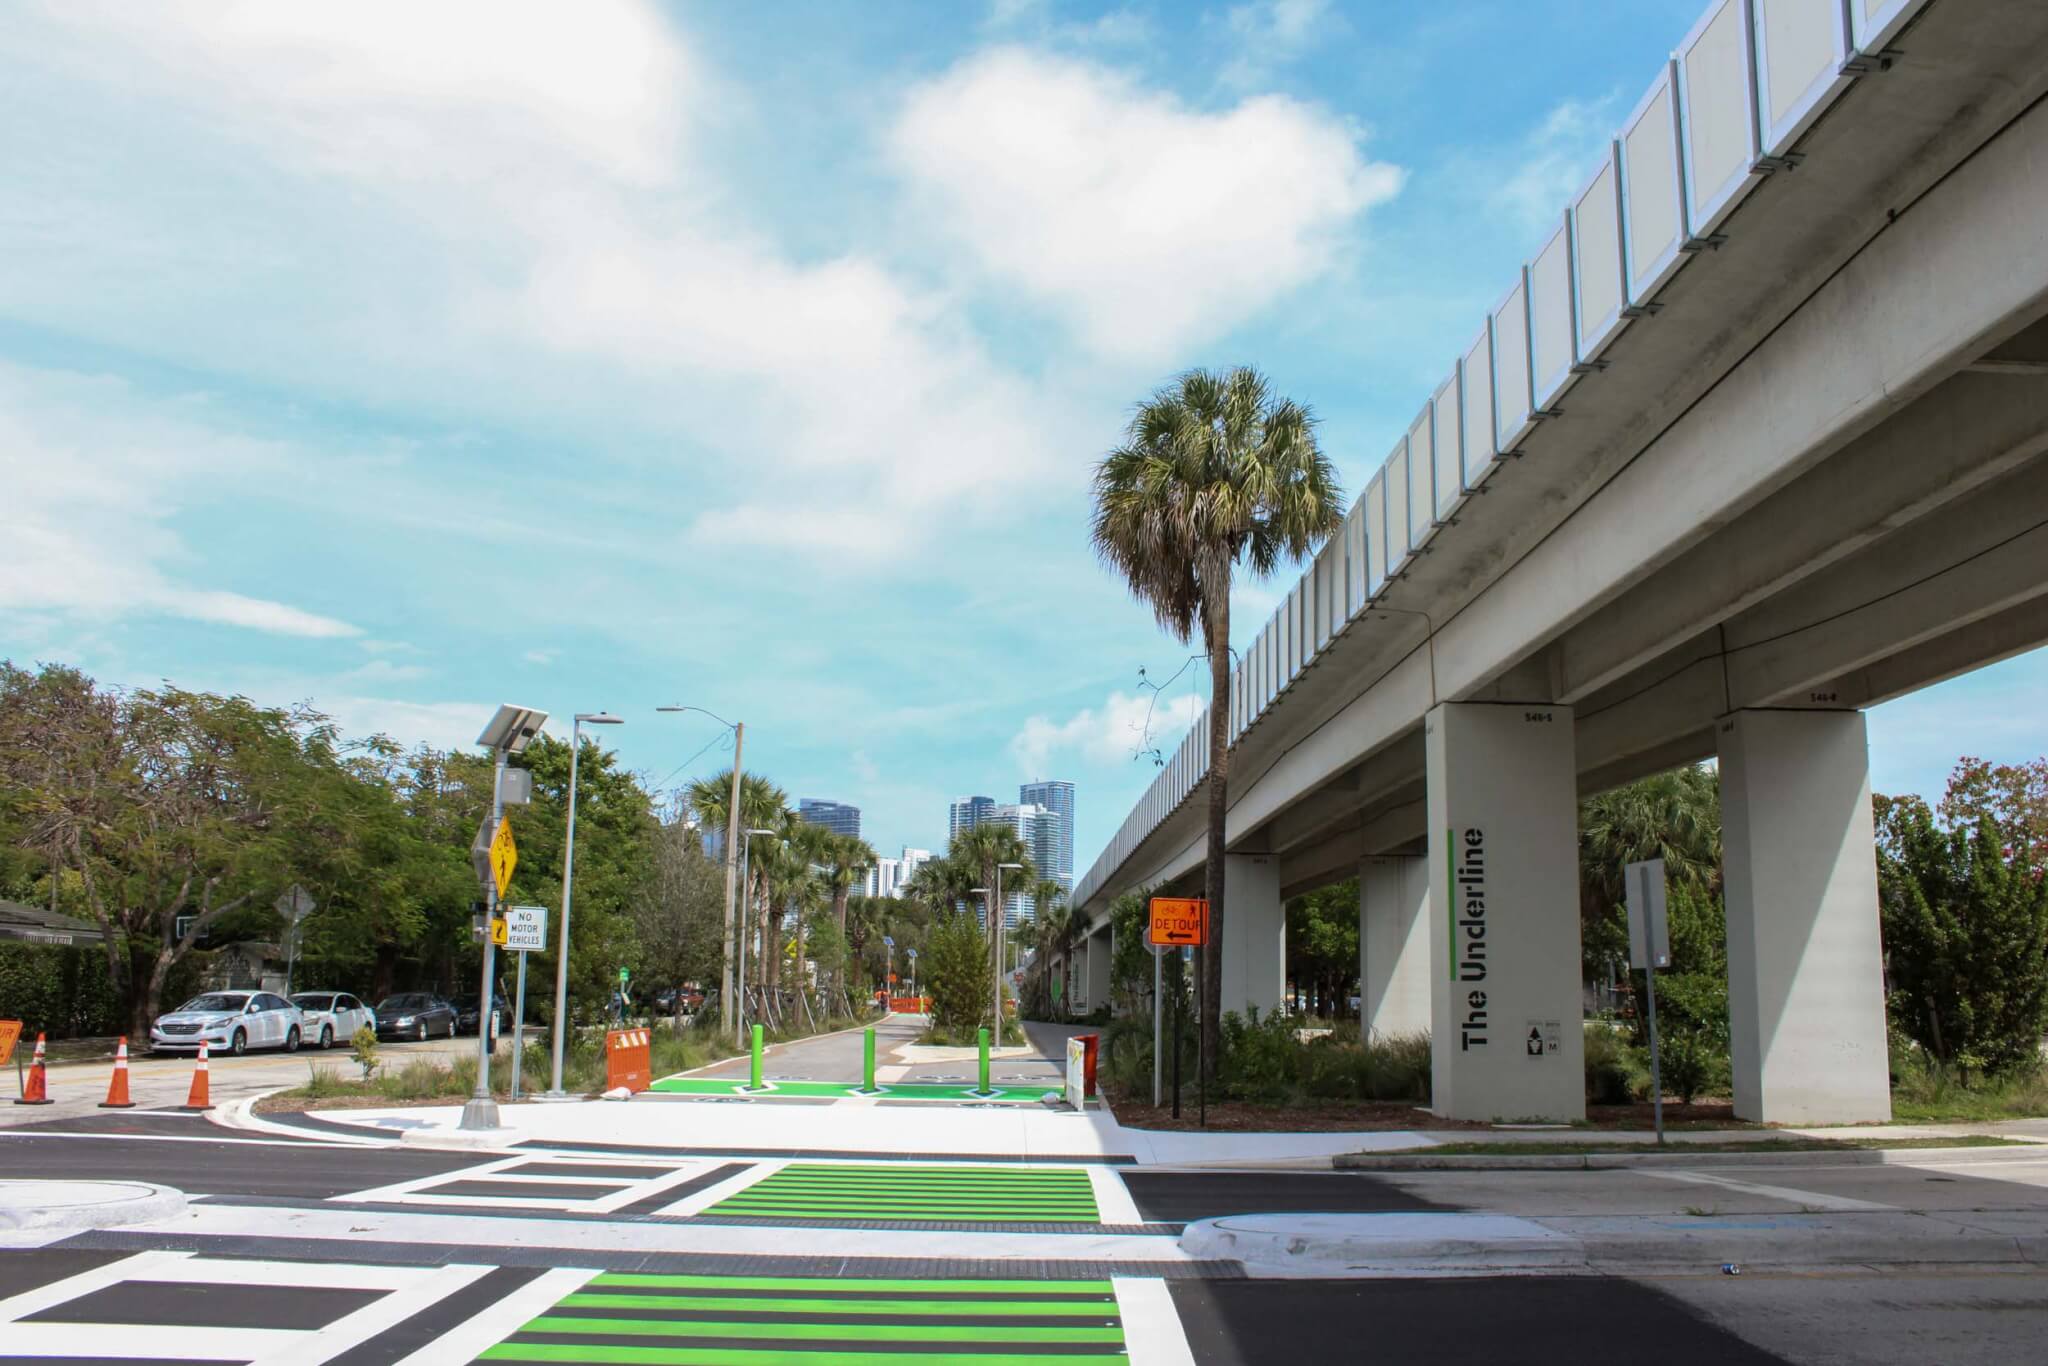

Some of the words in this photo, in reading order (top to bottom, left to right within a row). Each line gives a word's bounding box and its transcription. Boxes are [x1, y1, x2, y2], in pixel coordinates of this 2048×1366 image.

[1457, 828, 1488, 982] Underline
[518, 912, 533, 921] NO
[511, 924, 538, 933] MOTOR
[1155, 918, 1201, 931] DETOUR
[509, 935, 541, 945] VEHICLES
[1461, 990, 1488, 1051] The
